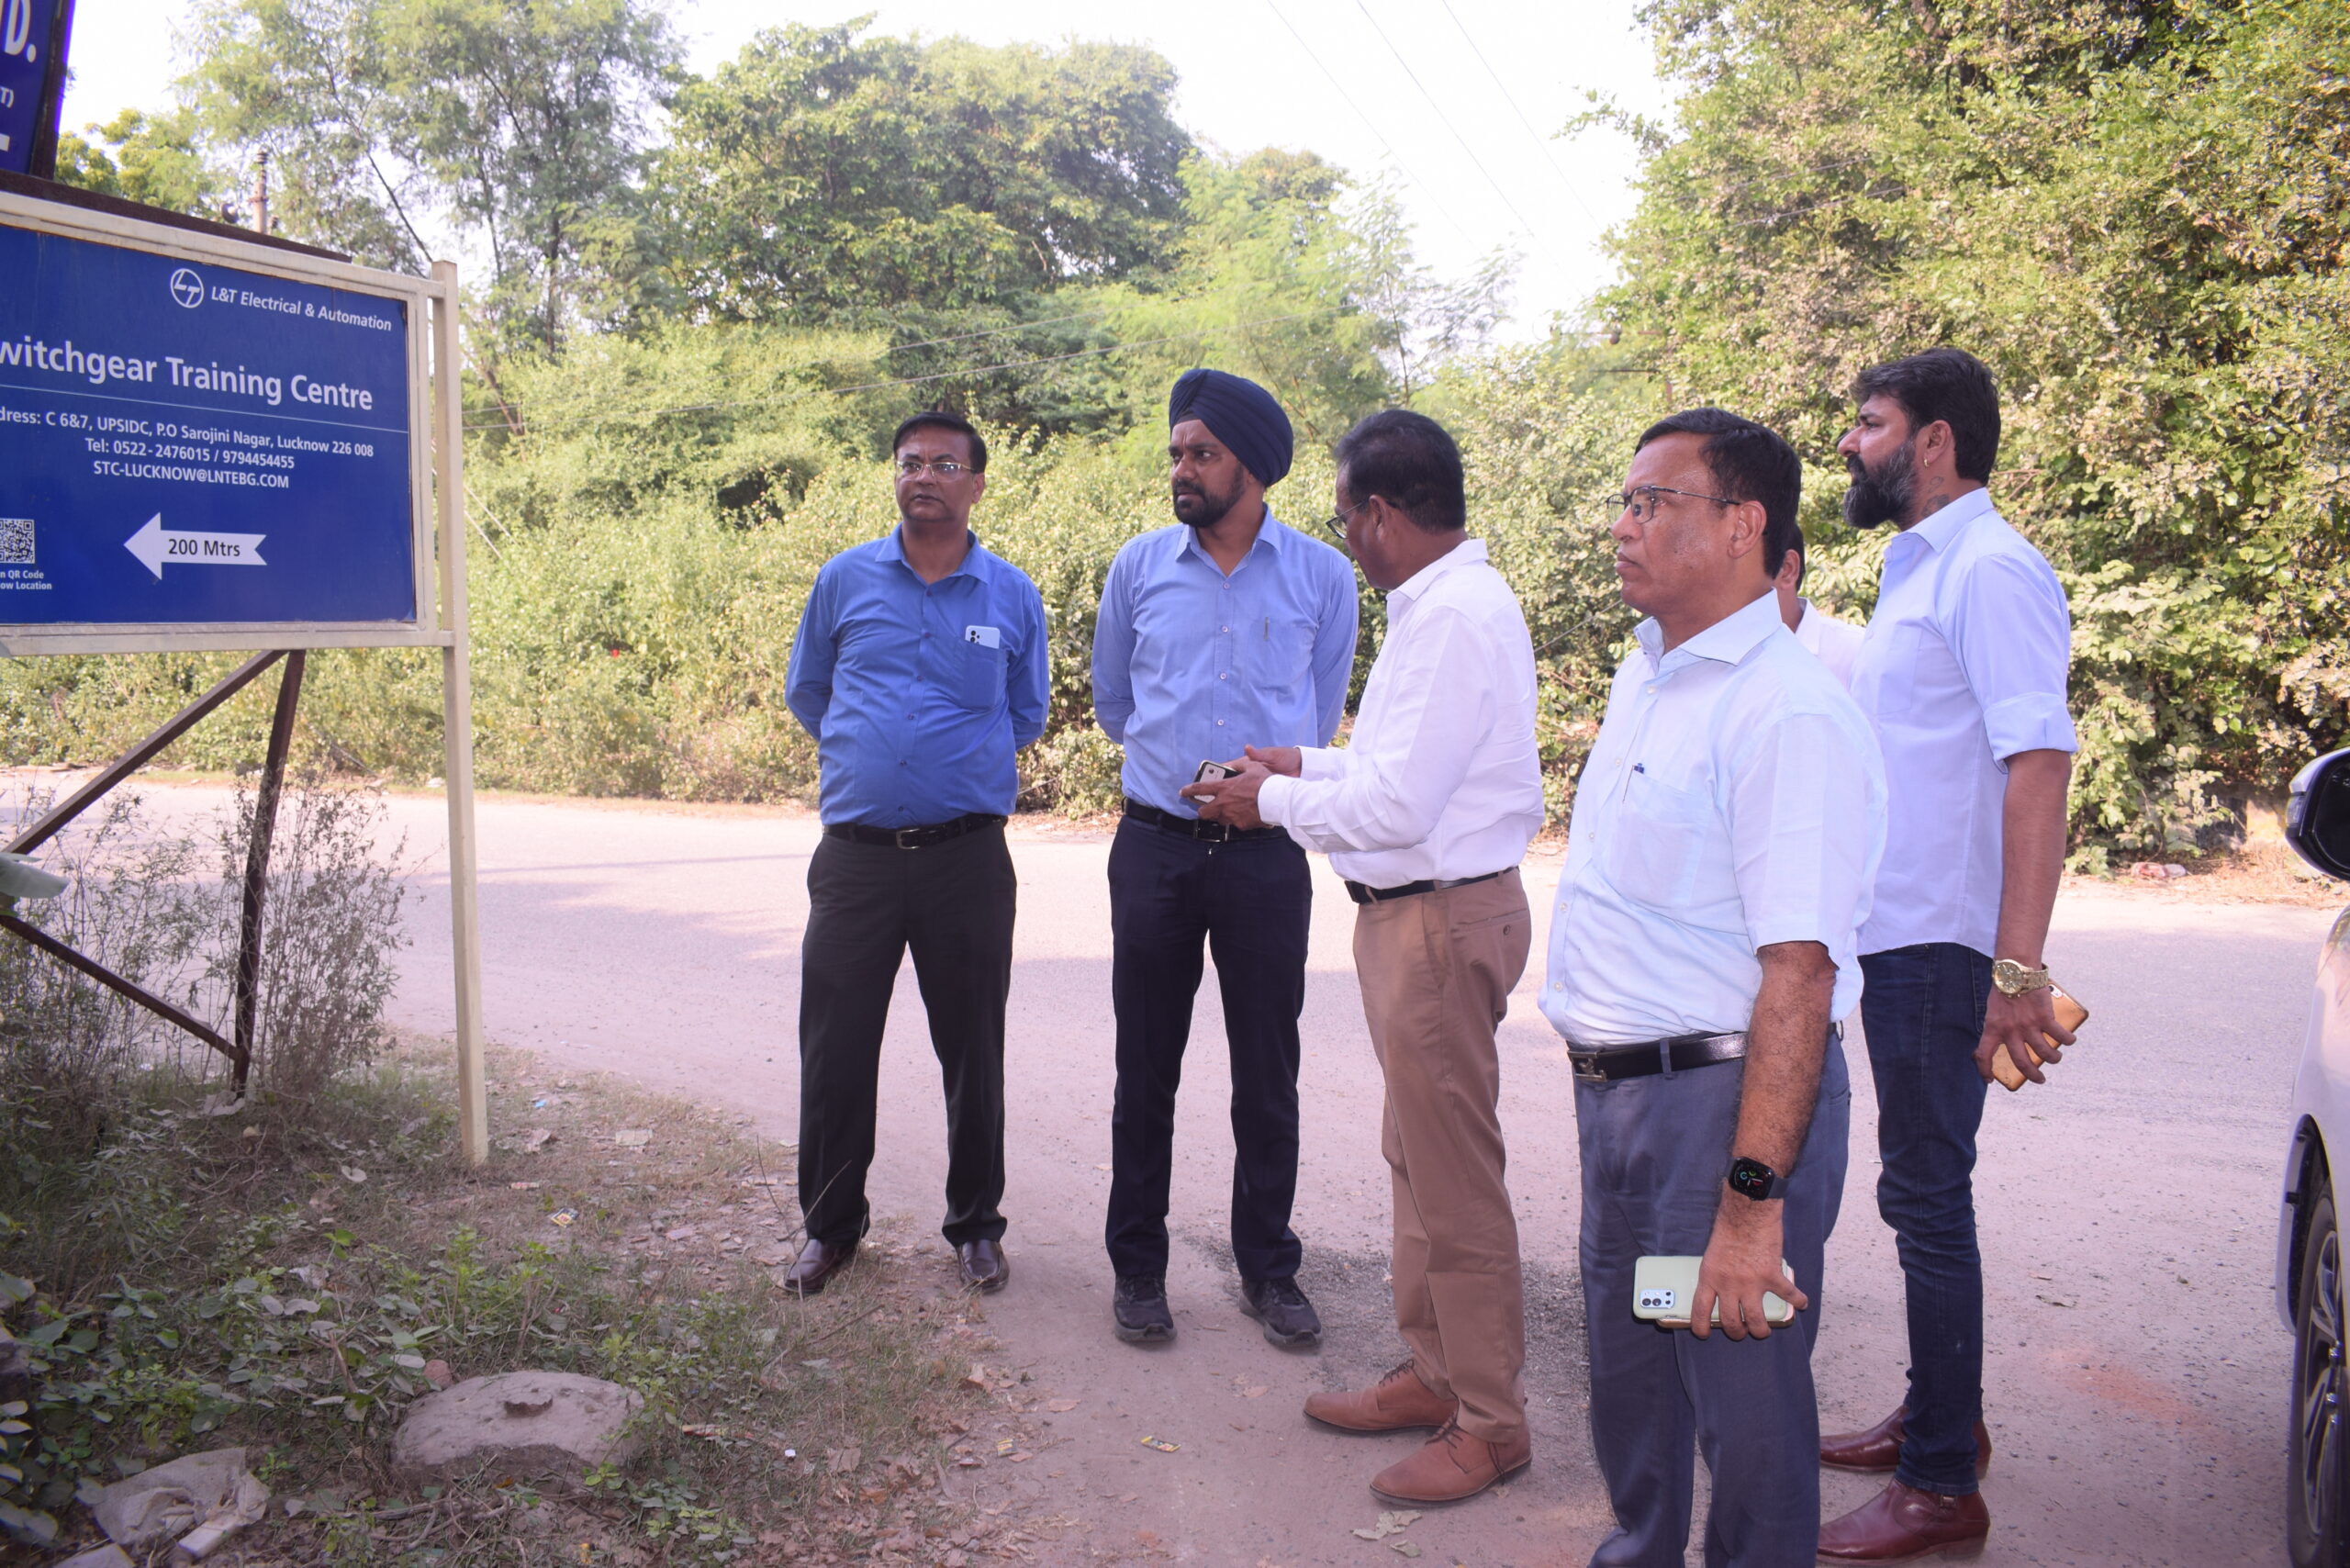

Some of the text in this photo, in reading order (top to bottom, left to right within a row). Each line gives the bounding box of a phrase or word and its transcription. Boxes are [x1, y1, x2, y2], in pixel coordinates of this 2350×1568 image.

[211, 286, 392, 331] L&T Electrical & Automation
[165, 356, 282, 406] Training
[291, 375, 373, 410] Centre
[46, 412, 56, 425] C
[60, 413, 93, 431] 6&7,
[97, 417, 152, 436] UPSIDC,
[156, 423, 177, 437] P.O
[181, 425, 229, 444] Sarojini
[233, 431, 274, 449] Nagar,
[277, 435, 330, 452] Lucknow
[332, 441, 352, 454] 226
[354, 443, 374, 457] 008
[85, 438, 109, 453] Tel:
[214, 450, 219, 462] /
[223, 451, 295, 469] 9794454455
[94, 461, 289, 488] STC-LUCKNOW@LNTEBG.COM
[168, 538, 241, 557] 200 Mtrs
[7, 570, 21, 579] QR
[22, 570, 45, 579] Code
[16, 581, 52, 590] Location
